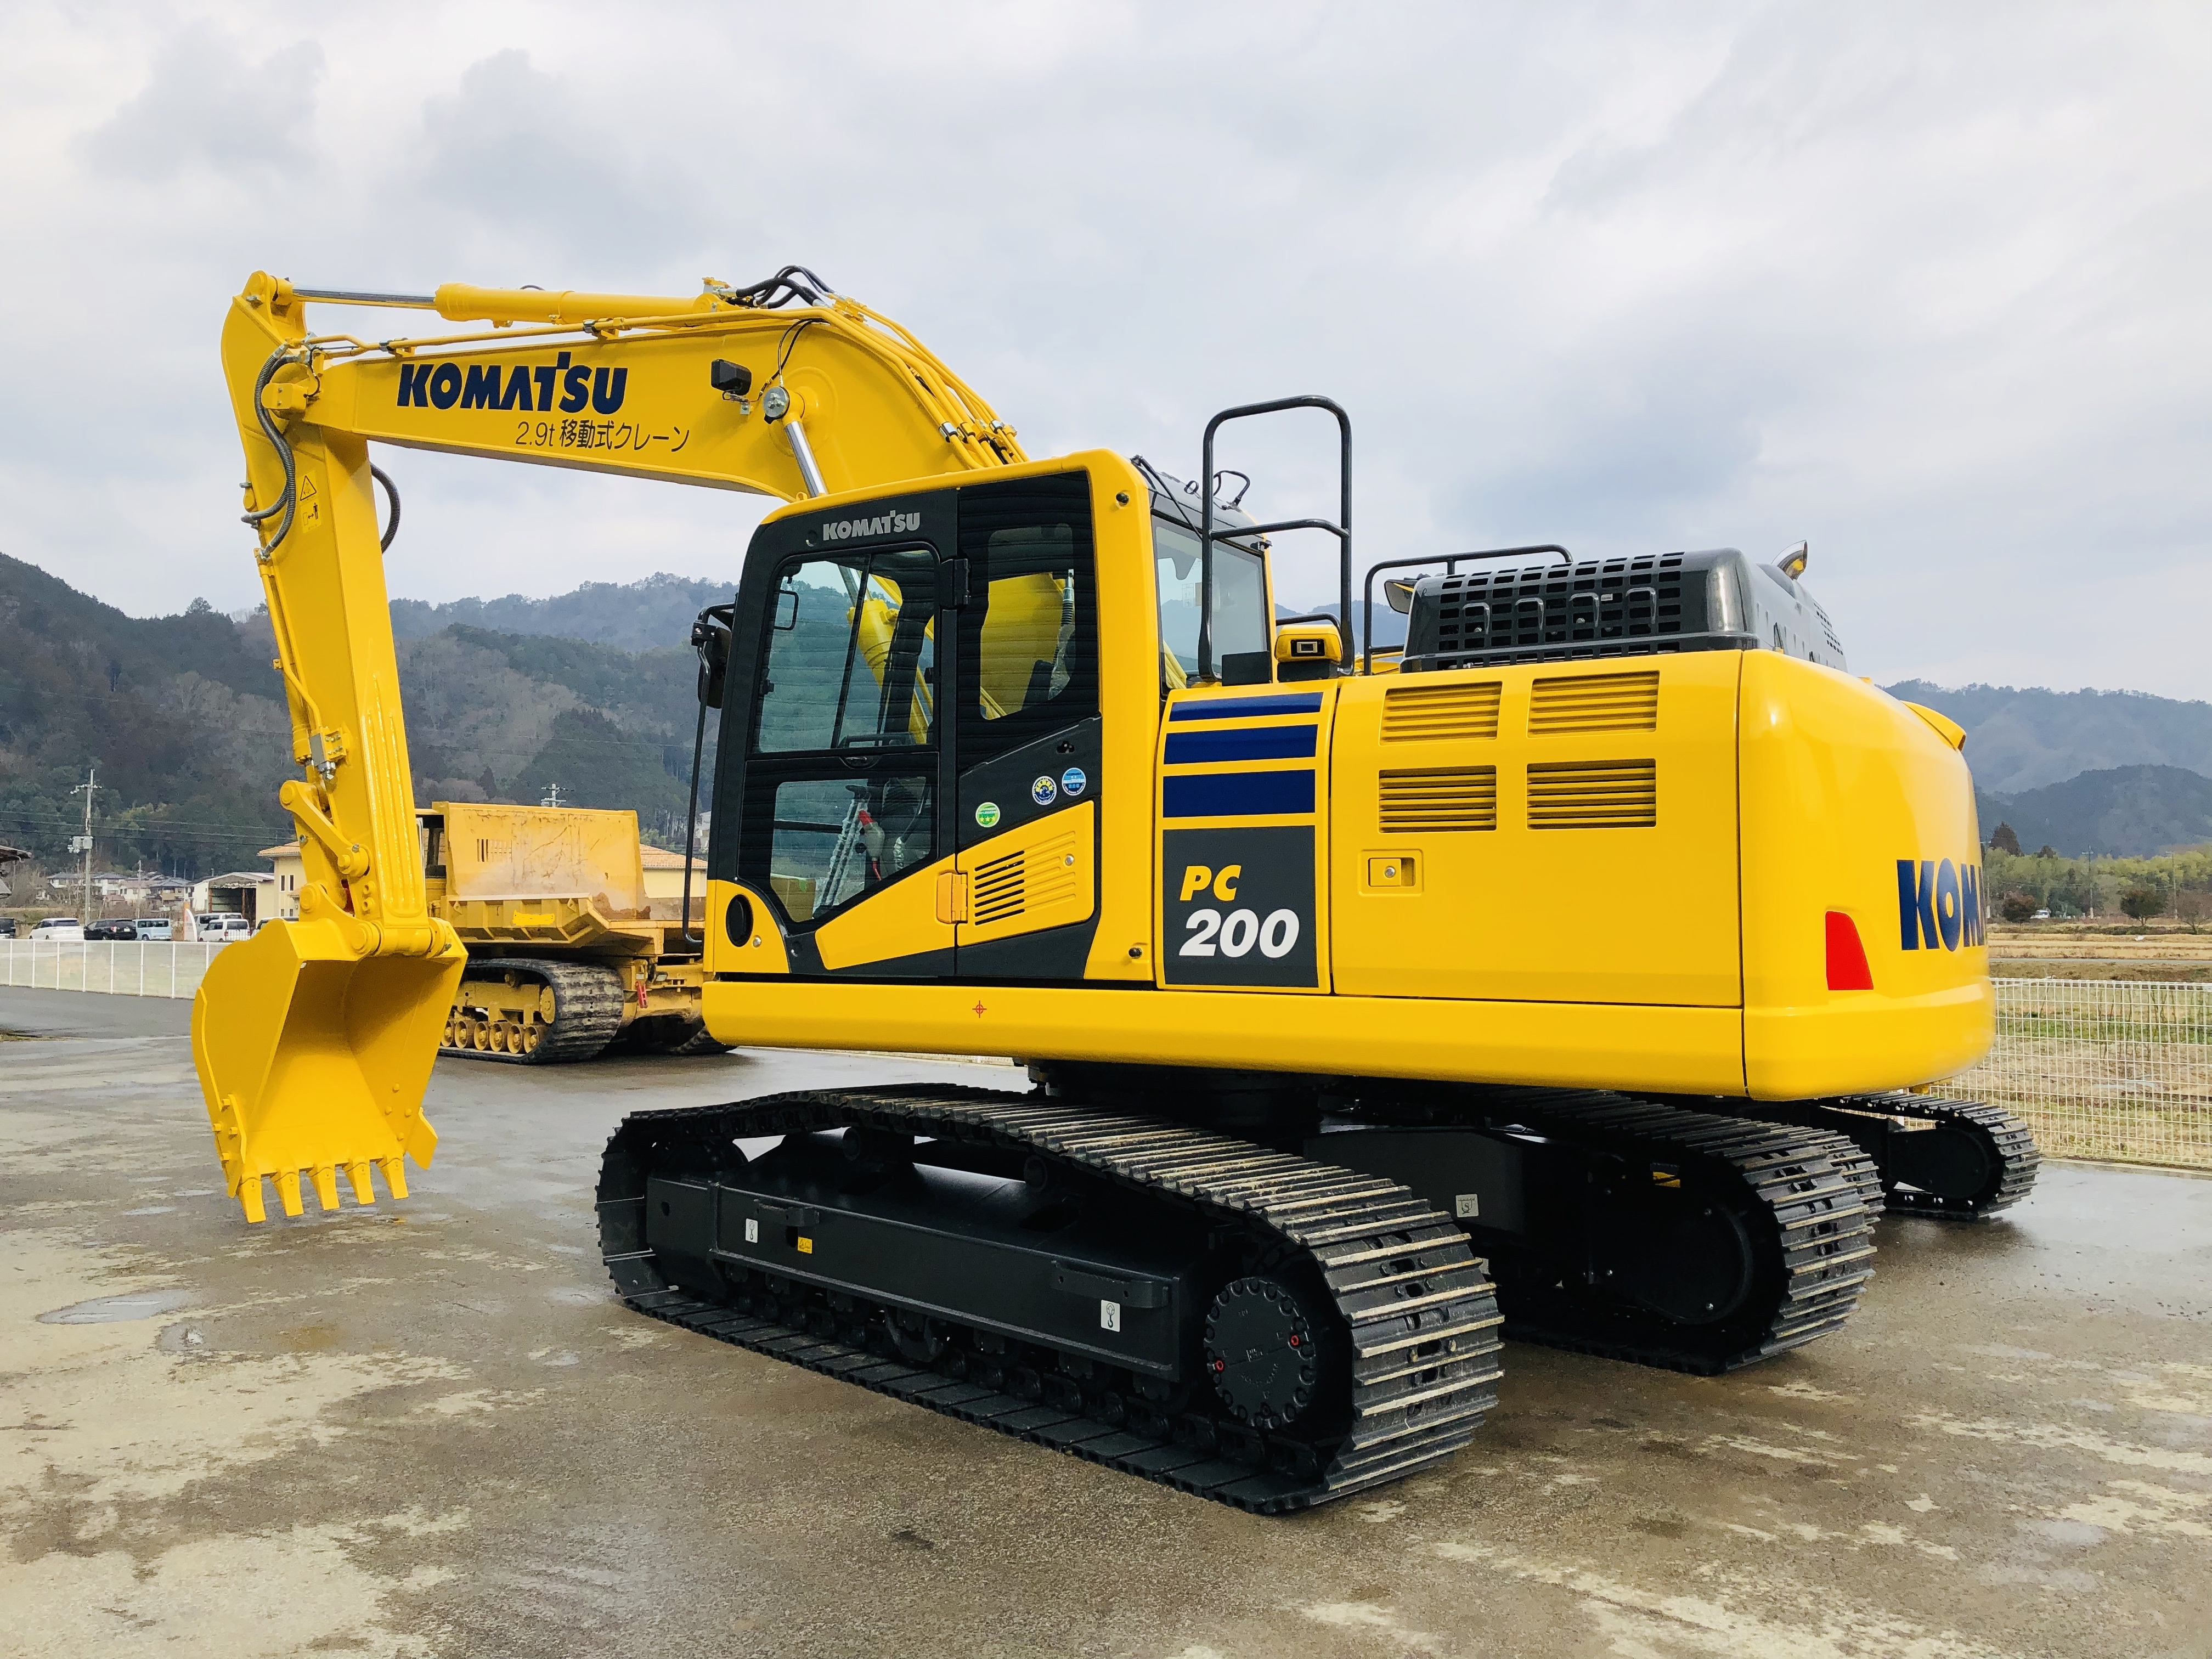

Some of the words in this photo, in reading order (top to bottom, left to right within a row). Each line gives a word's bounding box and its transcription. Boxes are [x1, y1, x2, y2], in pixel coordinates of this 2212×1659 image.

[397, 351, 628, 414] KOMATSU
[515, 421, 555, 447] 2.9t
[559, 419, 690, 452] 移動式クレーン
[823, 510, 920, 540] KOMATSU
[1180, 865, 1242, 901] PC
[1179, 909, 1300, 958] 200
